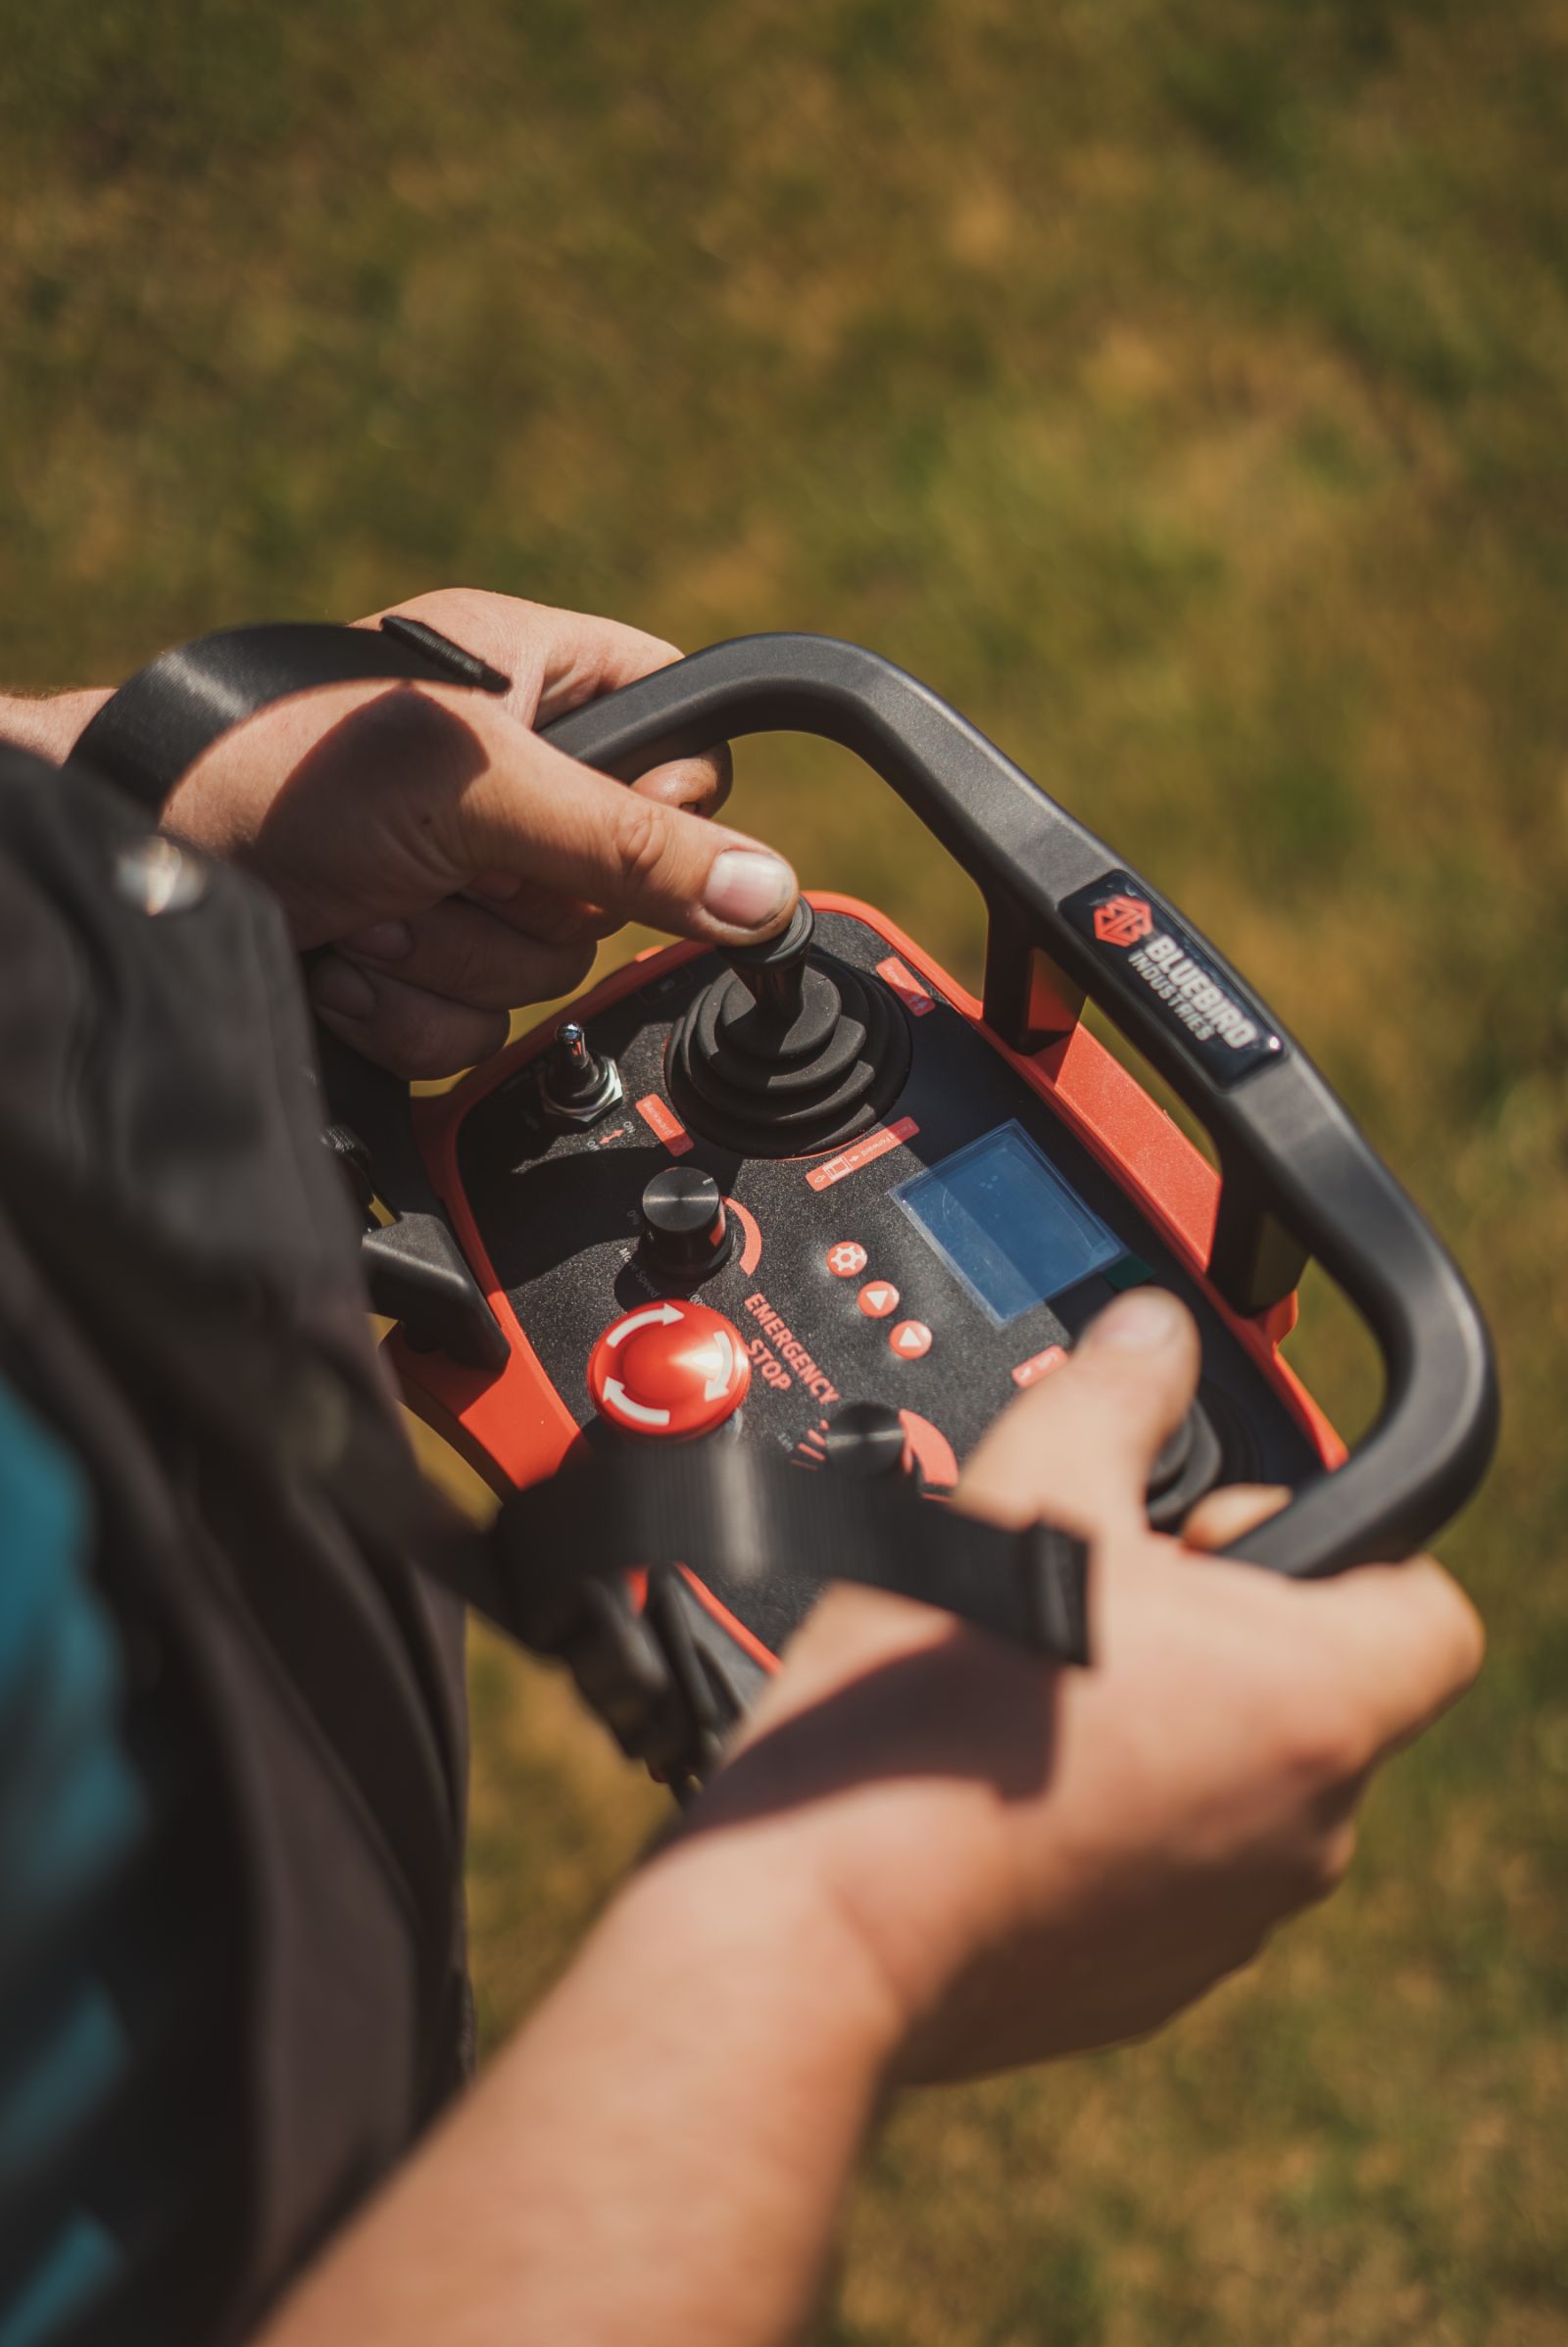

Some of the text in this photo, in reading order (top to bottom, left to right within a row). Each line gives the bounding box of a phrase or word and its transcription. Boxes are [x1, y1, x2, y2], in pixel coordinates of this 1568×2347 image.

[1128, 950, 1215, 1042] INDUSTRIES
[1145, 935, 1258, 1049] BLUEBIRD
[623, 1121, 637, 1134] ON
[745, 1293, 841, 1404] EMERGENCY
[748, 1339, 793, 1391] STOP
